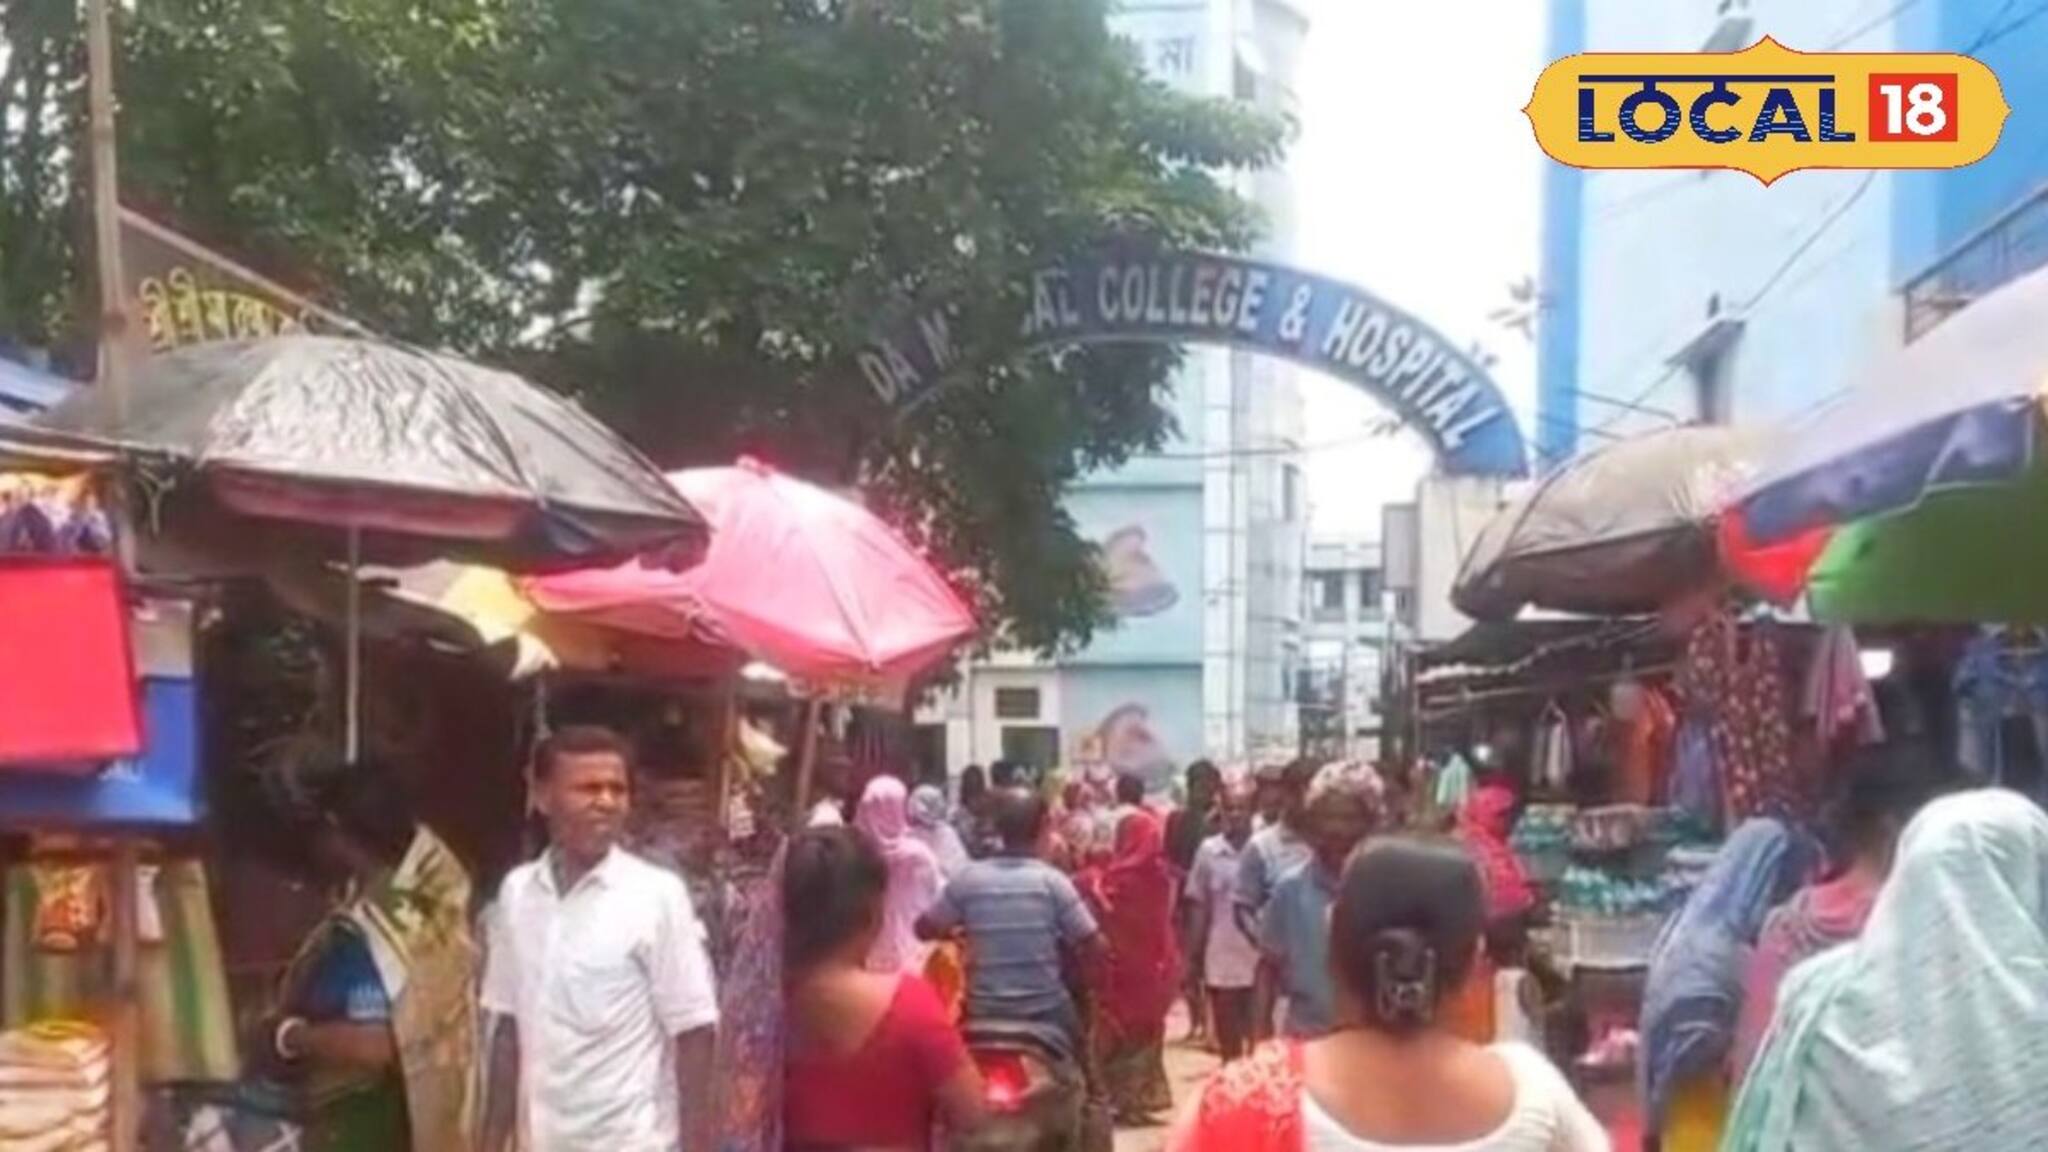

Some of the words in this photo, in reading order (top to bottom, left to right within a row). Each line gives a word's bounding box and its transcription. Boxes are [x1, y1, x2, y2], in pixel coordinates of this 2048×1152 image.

[1097, 262, 1267, 331] COLLEGE
[1280, 281, 1312, 341] &
[1321, 298, 1502, 450] HOSPITAL
